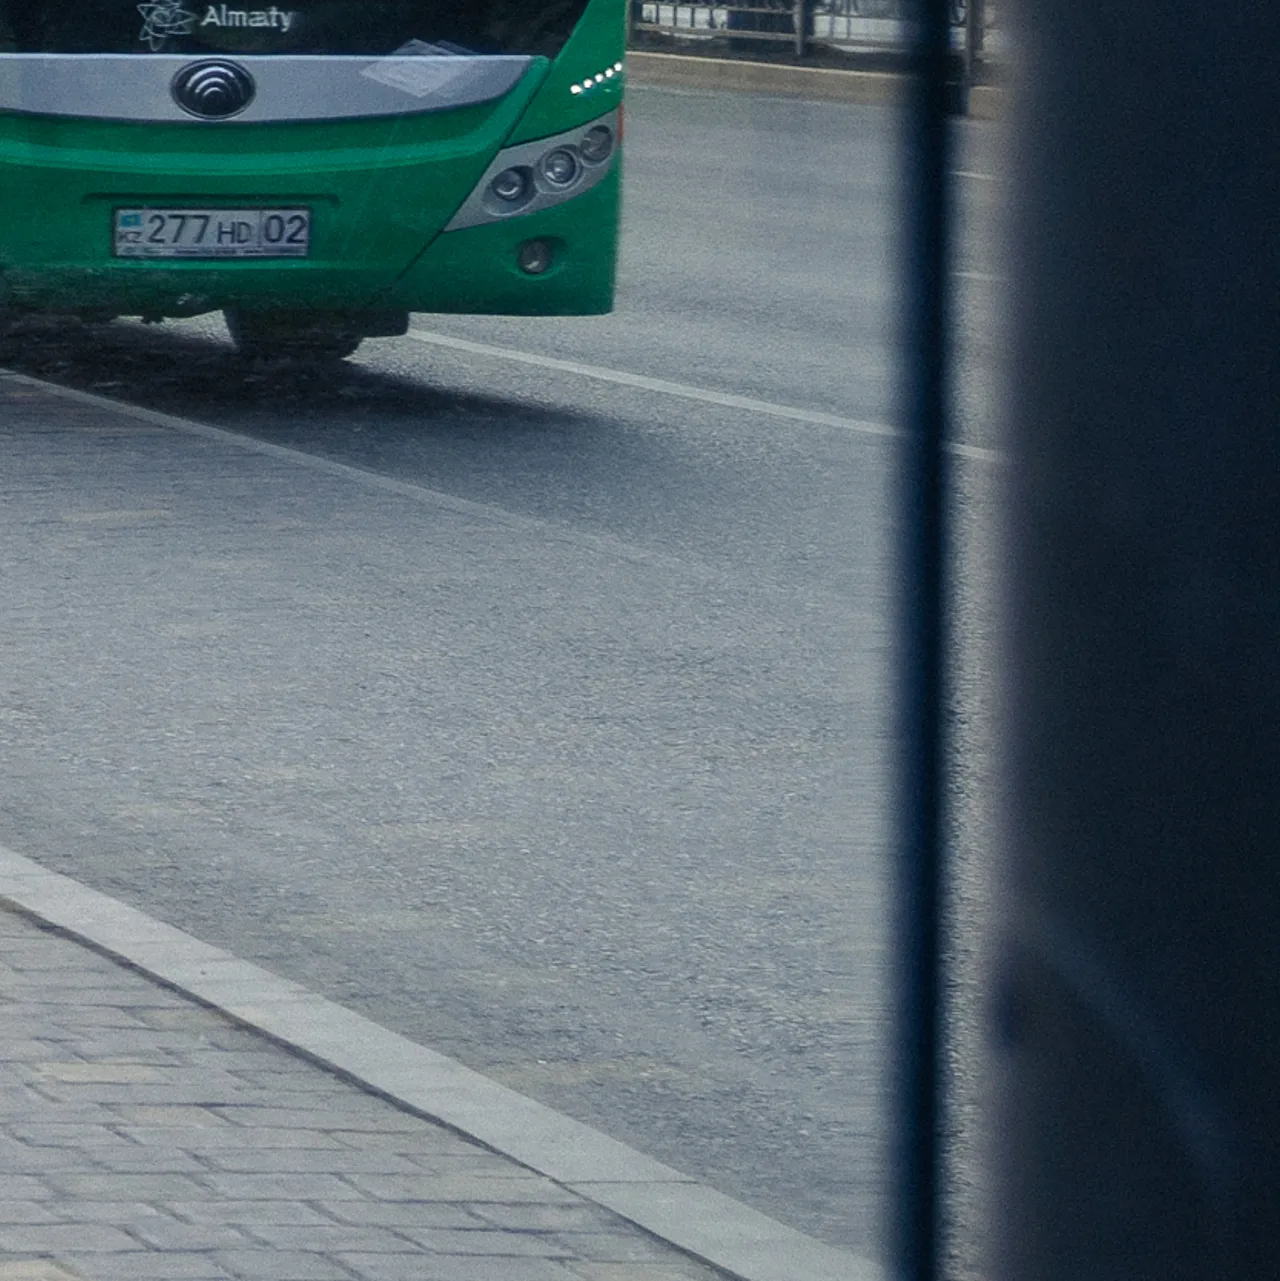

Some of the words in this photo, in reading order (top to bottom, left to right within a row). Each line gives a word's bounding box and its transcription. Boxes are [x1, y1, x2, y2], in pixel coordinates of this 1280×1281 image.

[199, 4, 294, 33] Almaty
[148, 214, 210, 244] 277
[264, 214, 307, 244] 02
